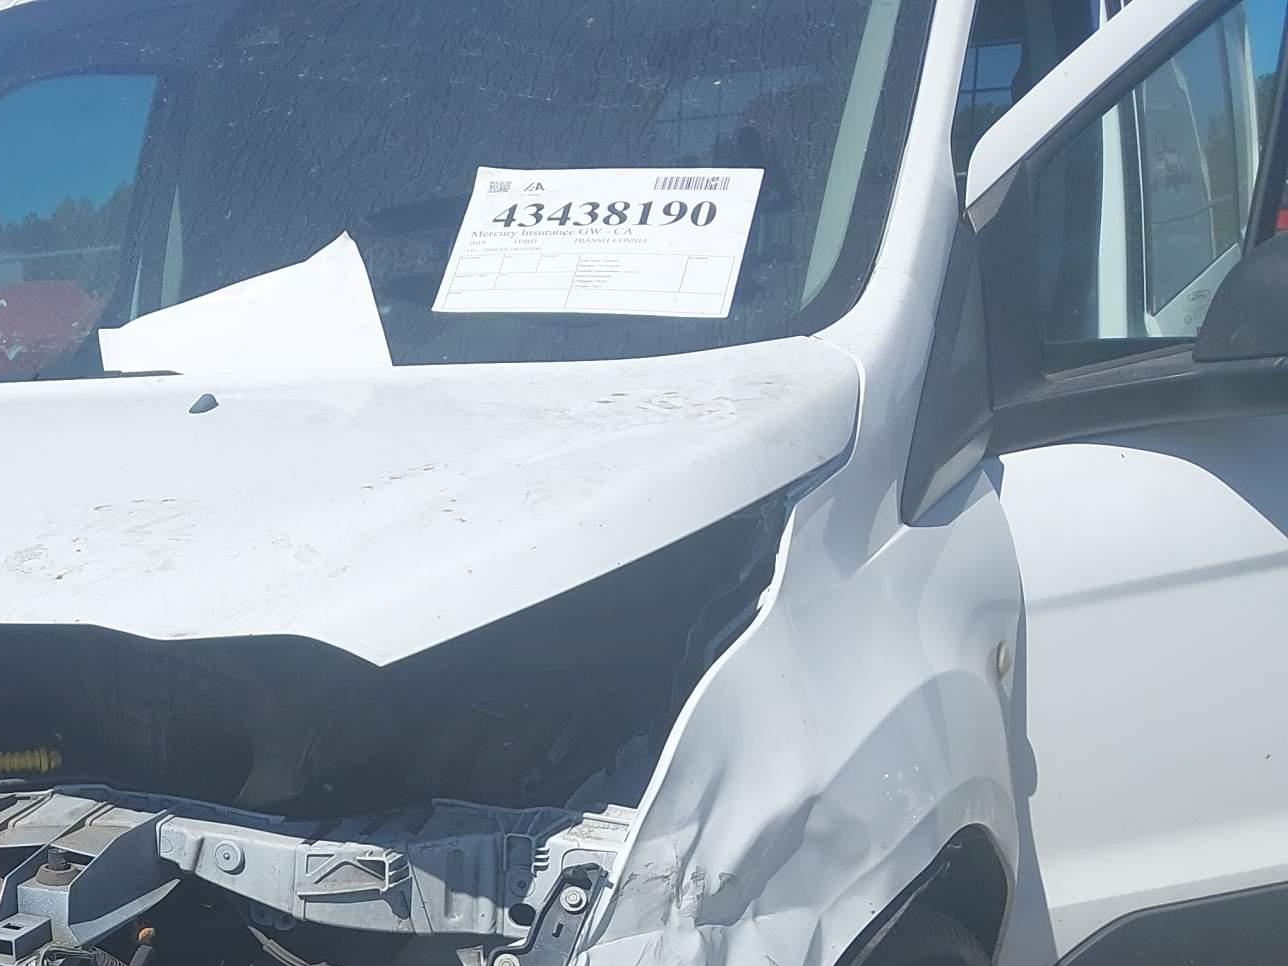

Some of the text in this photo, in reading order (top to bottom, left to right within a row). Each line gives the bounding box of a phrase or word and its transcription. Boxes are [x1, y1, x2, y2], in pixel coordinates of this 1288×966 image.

[492, 200, 718, 228] 43438190
[471, 230, 518, 239] Mercury
[521, 229, 575, 237] Insurance
